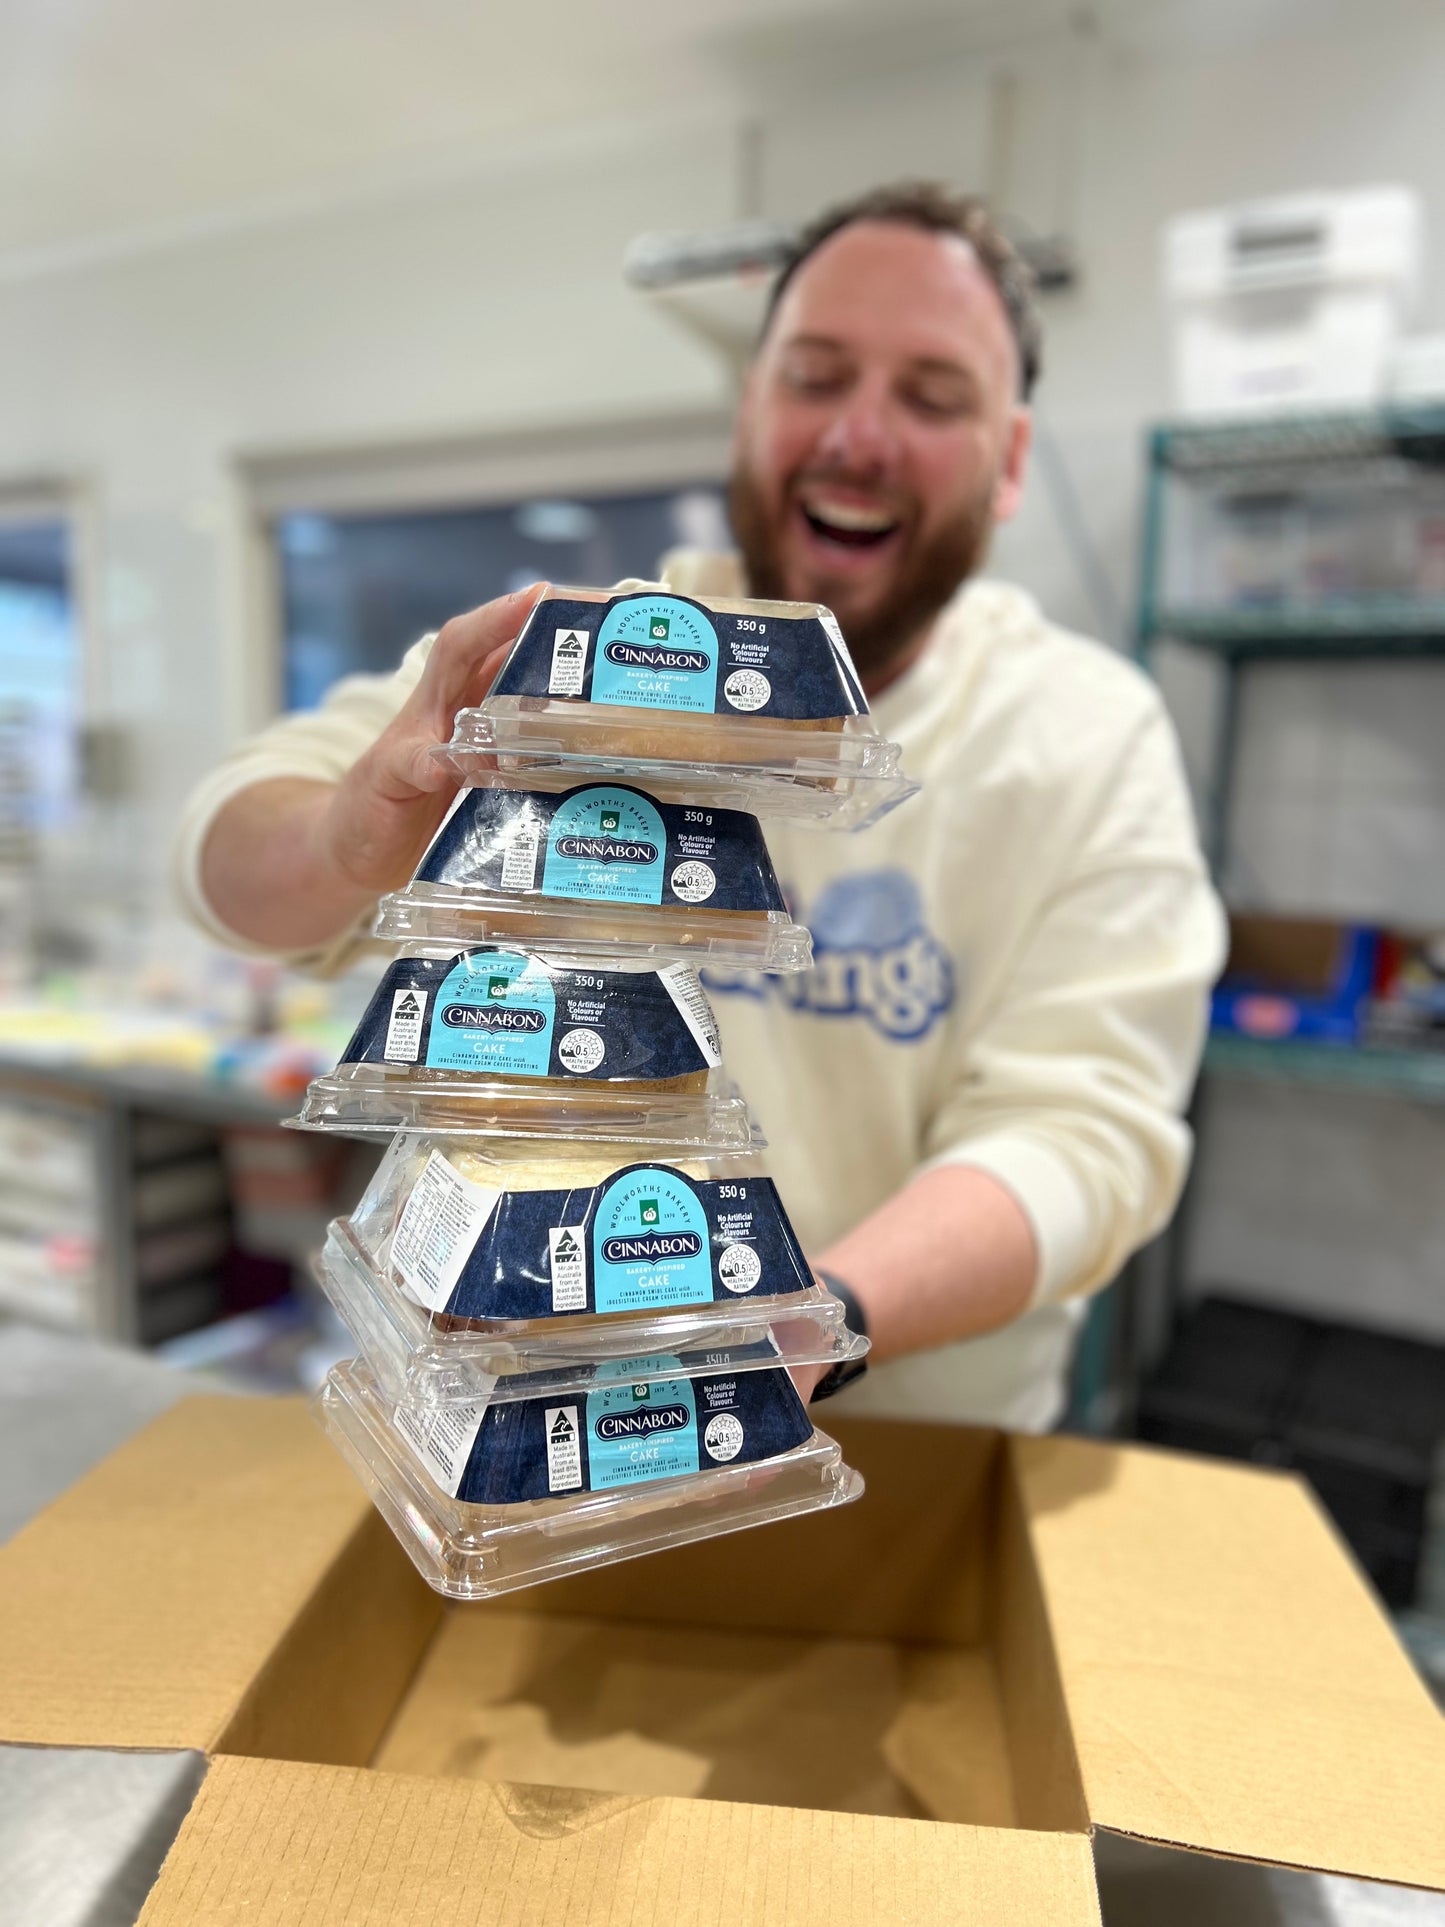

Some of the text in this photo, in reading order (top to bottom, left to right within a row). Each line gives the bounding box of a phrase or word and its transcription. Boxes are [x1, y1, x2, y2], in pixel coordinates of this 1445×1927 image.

[617, 608, 701, 645] WOOLWORTHS BAKERY
[737, 620, 766, 634] 350 g
[733, 649, 758, 657] Colours
[741, 643, 769, 652] Artificial
[611, 645, 703, 668] CINNABON
[638, 680, 670, 692] CAKE
[742, 685, 753, 695] 0.5
[569, 800, 649, 836] WOOLWORTHS BAKERY
[684, 811, 712, 825] 350 g
[688, 835, 715, 843] Artificial
[562, 840, 651, 859] CINNABON
[683, 847, 709, 855] Flavours
[588, 872, 619, 883] CAKE
[688, 877, 699, 886] 0.5
[575, 975, 603, 989] 350 g
[578, 1000, 605, 1009] Artificial
[569, 1007, 594, 1015] Colours
[448, 1009, 538, 1027] CINNABON
[572, 1014, 598, 1022] Flavours
[473, 1043, 505, 1054] CAKE
[576, 1045, 587, 1056] 0.5
[719, 1186, 746, 1199] 350 g
[611, 1185, 691, 1228] WOOLWORTHS BAKERY
[718, 1213, 752, 1222] No Artificial
[608, 1238, 697, 1258] CINNABON
[735, 1263, 745, 1274] 0.5
[638, 1274, 669, 1287] CAKE
[713, 1382, 736, 1391] Artificial
[707, 1392, 727, 1400] Colours
[710, 1398, 733, 1407] Flavours
[601, 1410, 684, 1435] CINNABON
[719, 1432, 729, 1443] 0.5
[630, 1448, 659, 1462] CAKE
[601, 1473, 632, 1482] IRRESISTIBLE
[669, 1462, 690, 1470] FROSTING
[613, 1465, 637, 1473] CINNAMON
[552, 1473, 578, 1481] Australian
[551, 1480, 580, 1488] ingredients
